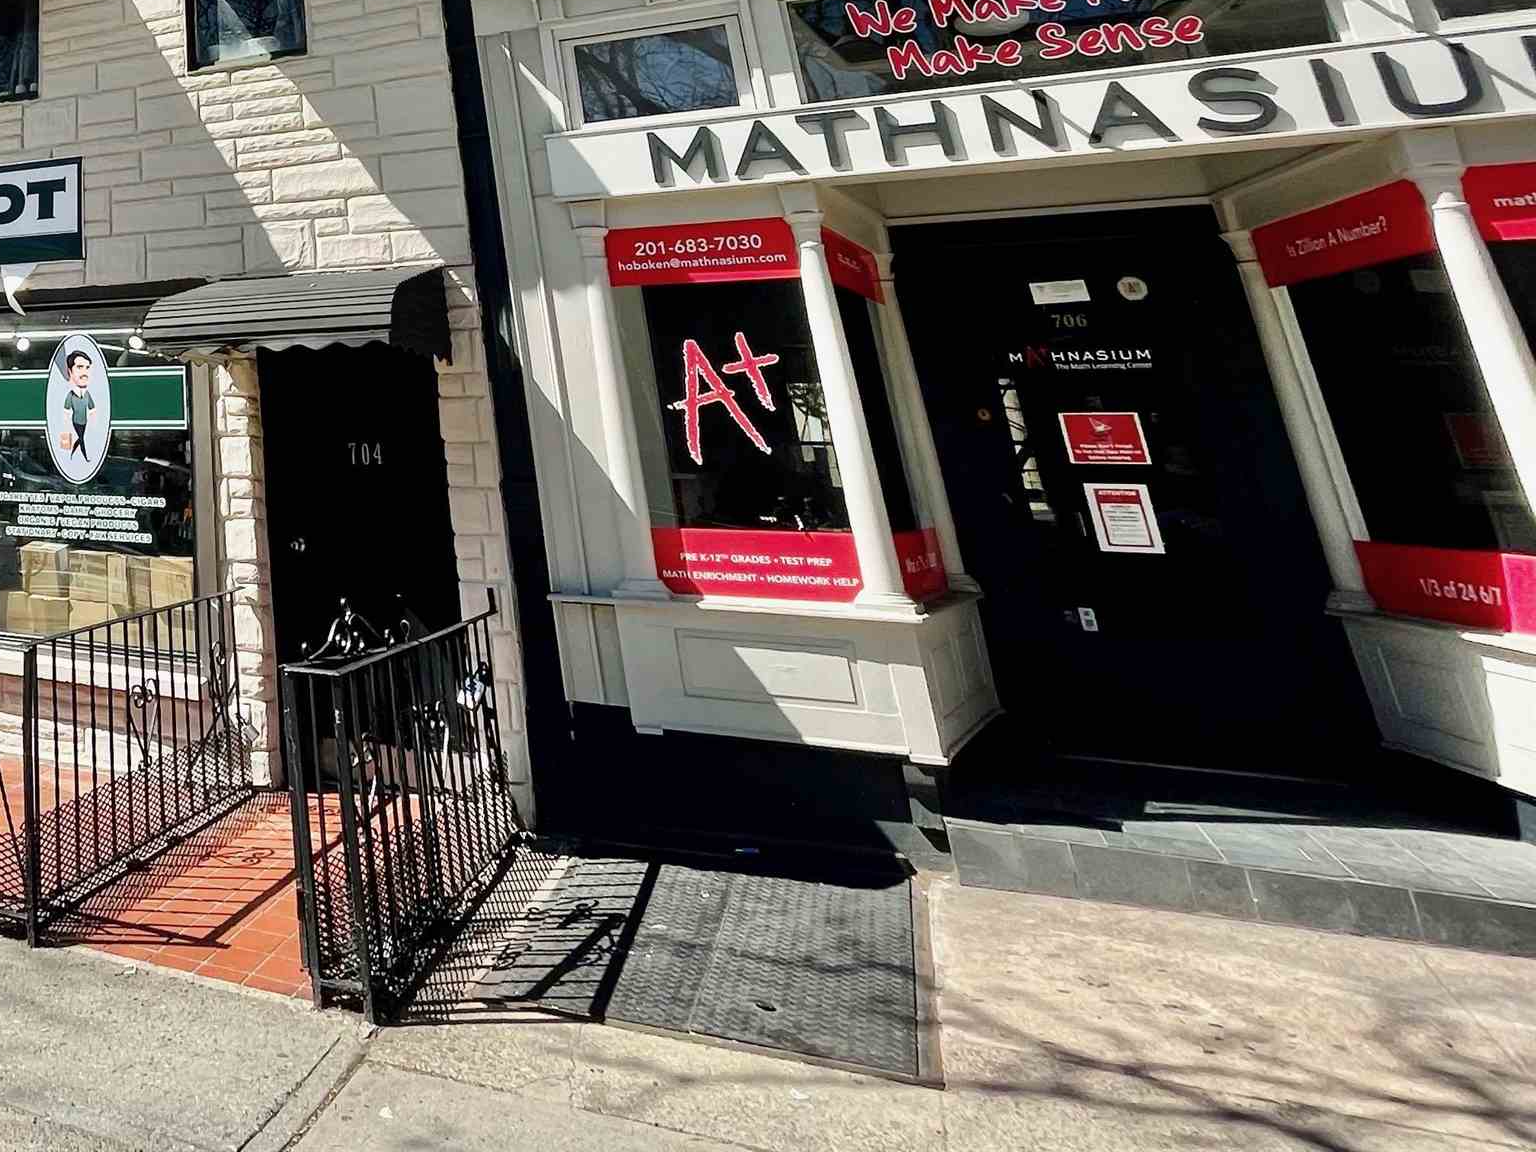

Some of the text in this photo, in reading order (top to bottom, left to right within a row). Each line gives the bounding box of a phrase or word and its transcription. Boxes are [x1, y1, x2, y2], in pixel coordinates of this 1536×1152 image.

[845, 0, 916, 38] We
[887, 15, 1204, 80] Make Sense
[646, 35, 1536, 188] MATHNASIU
[634, 233, 762, 257] 201-683-7030
[1296, 237, 1326, 255] Zillion
[1328, 231, 1338, 246] A
[1337, 215, 1388, 243] Number?
[618, 251, 787, 272] hoboken@mathnasium.com
[1051, 313, 1088, 328] 706
[667, 331, 780, 466] A+
[348, 442, 383, 465] 704
[18, 504, 59, 514] KRATOMS
[94, 507, 138, 518] GROCERY
[78, 495, 126, 505] PRODUCTS
[130, 497, 166, 508] CIGARS
[90, 518, 139, 531] PRODUCTS
[61, 529, 86, 540] COPY
[108, 531, 152, 543] SERVICES
[680, 552, 698, 561] PRE
[730, 553, 772, 564] GRADES
[779, 555, 805, 566] TEST
[806, 557, 832, 566] PREP
[663, 569, 859, 587] MATH ENRICHMENT HOMEWORK HELP
